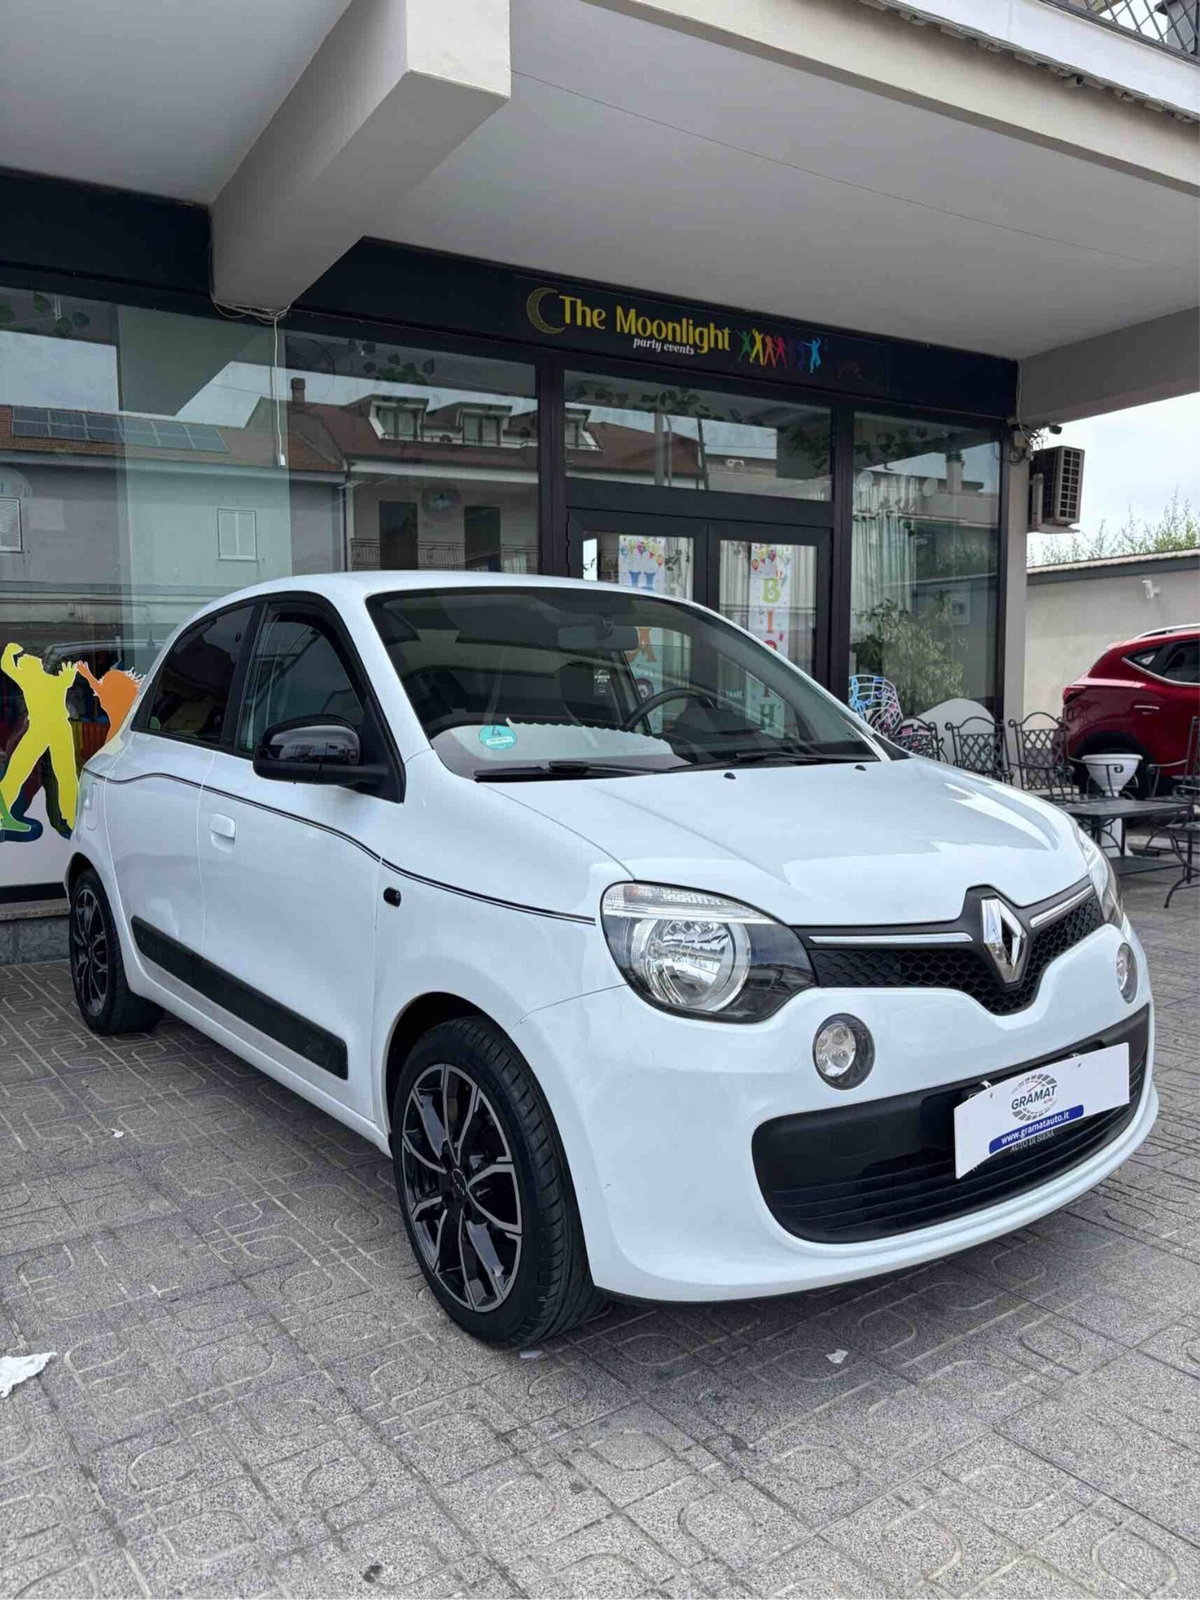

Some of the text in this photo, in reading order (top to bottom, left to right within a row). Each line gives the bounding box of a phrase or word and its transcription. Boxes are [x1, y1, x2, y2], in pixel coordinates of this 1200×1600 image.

[558, 295, 731, 354] The Moonlight
[633, 337, 695, 355] party events
[1011, 1084, 1058, 1111] GRAMAT
[1000, 1111, 1070, 1145] www.gramatauto.it
[1010, 1139, 1028, 1153] AUTO
